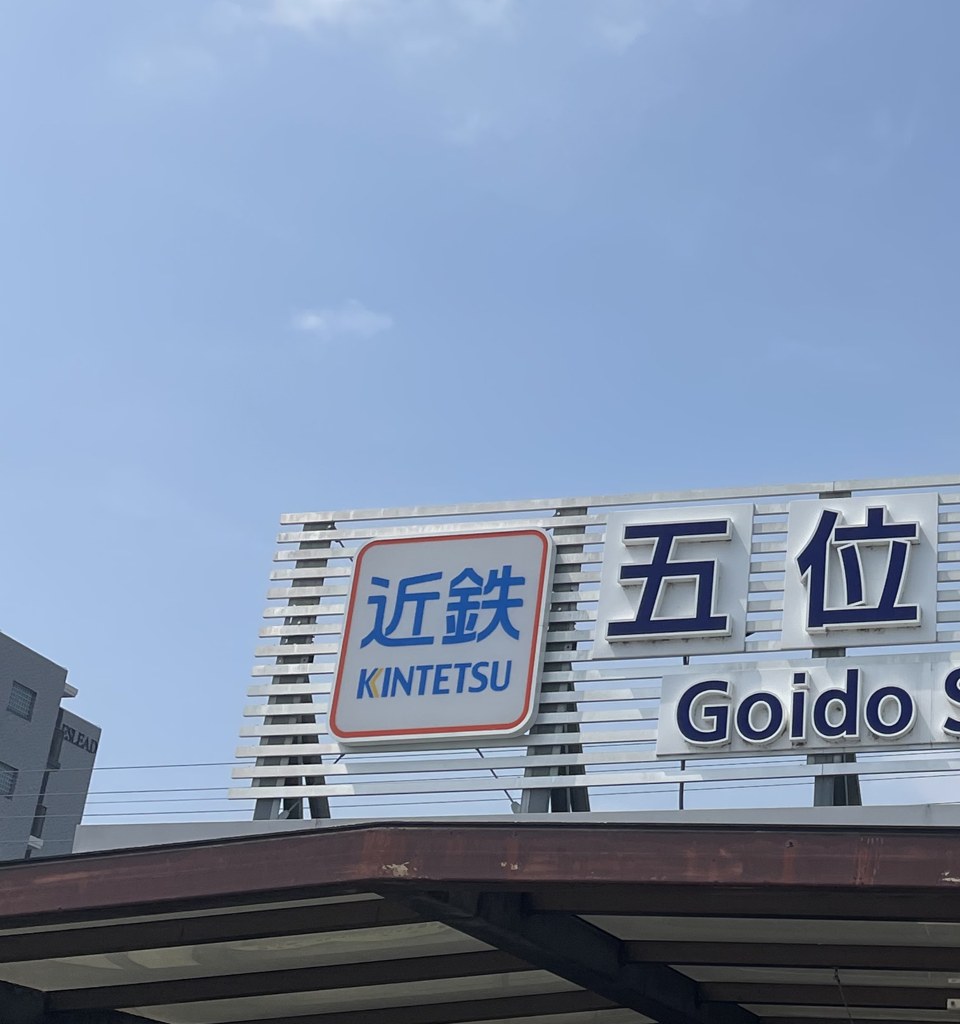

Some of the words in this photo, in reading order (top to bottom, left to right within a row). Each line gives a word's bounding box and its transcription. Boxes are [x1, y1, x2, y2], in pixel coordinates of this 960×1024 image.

[360, 565, 526, 649] 近鉄
[356, 660, 512, 700] KINTETSU
[676, 667, 914, 744] Goido
